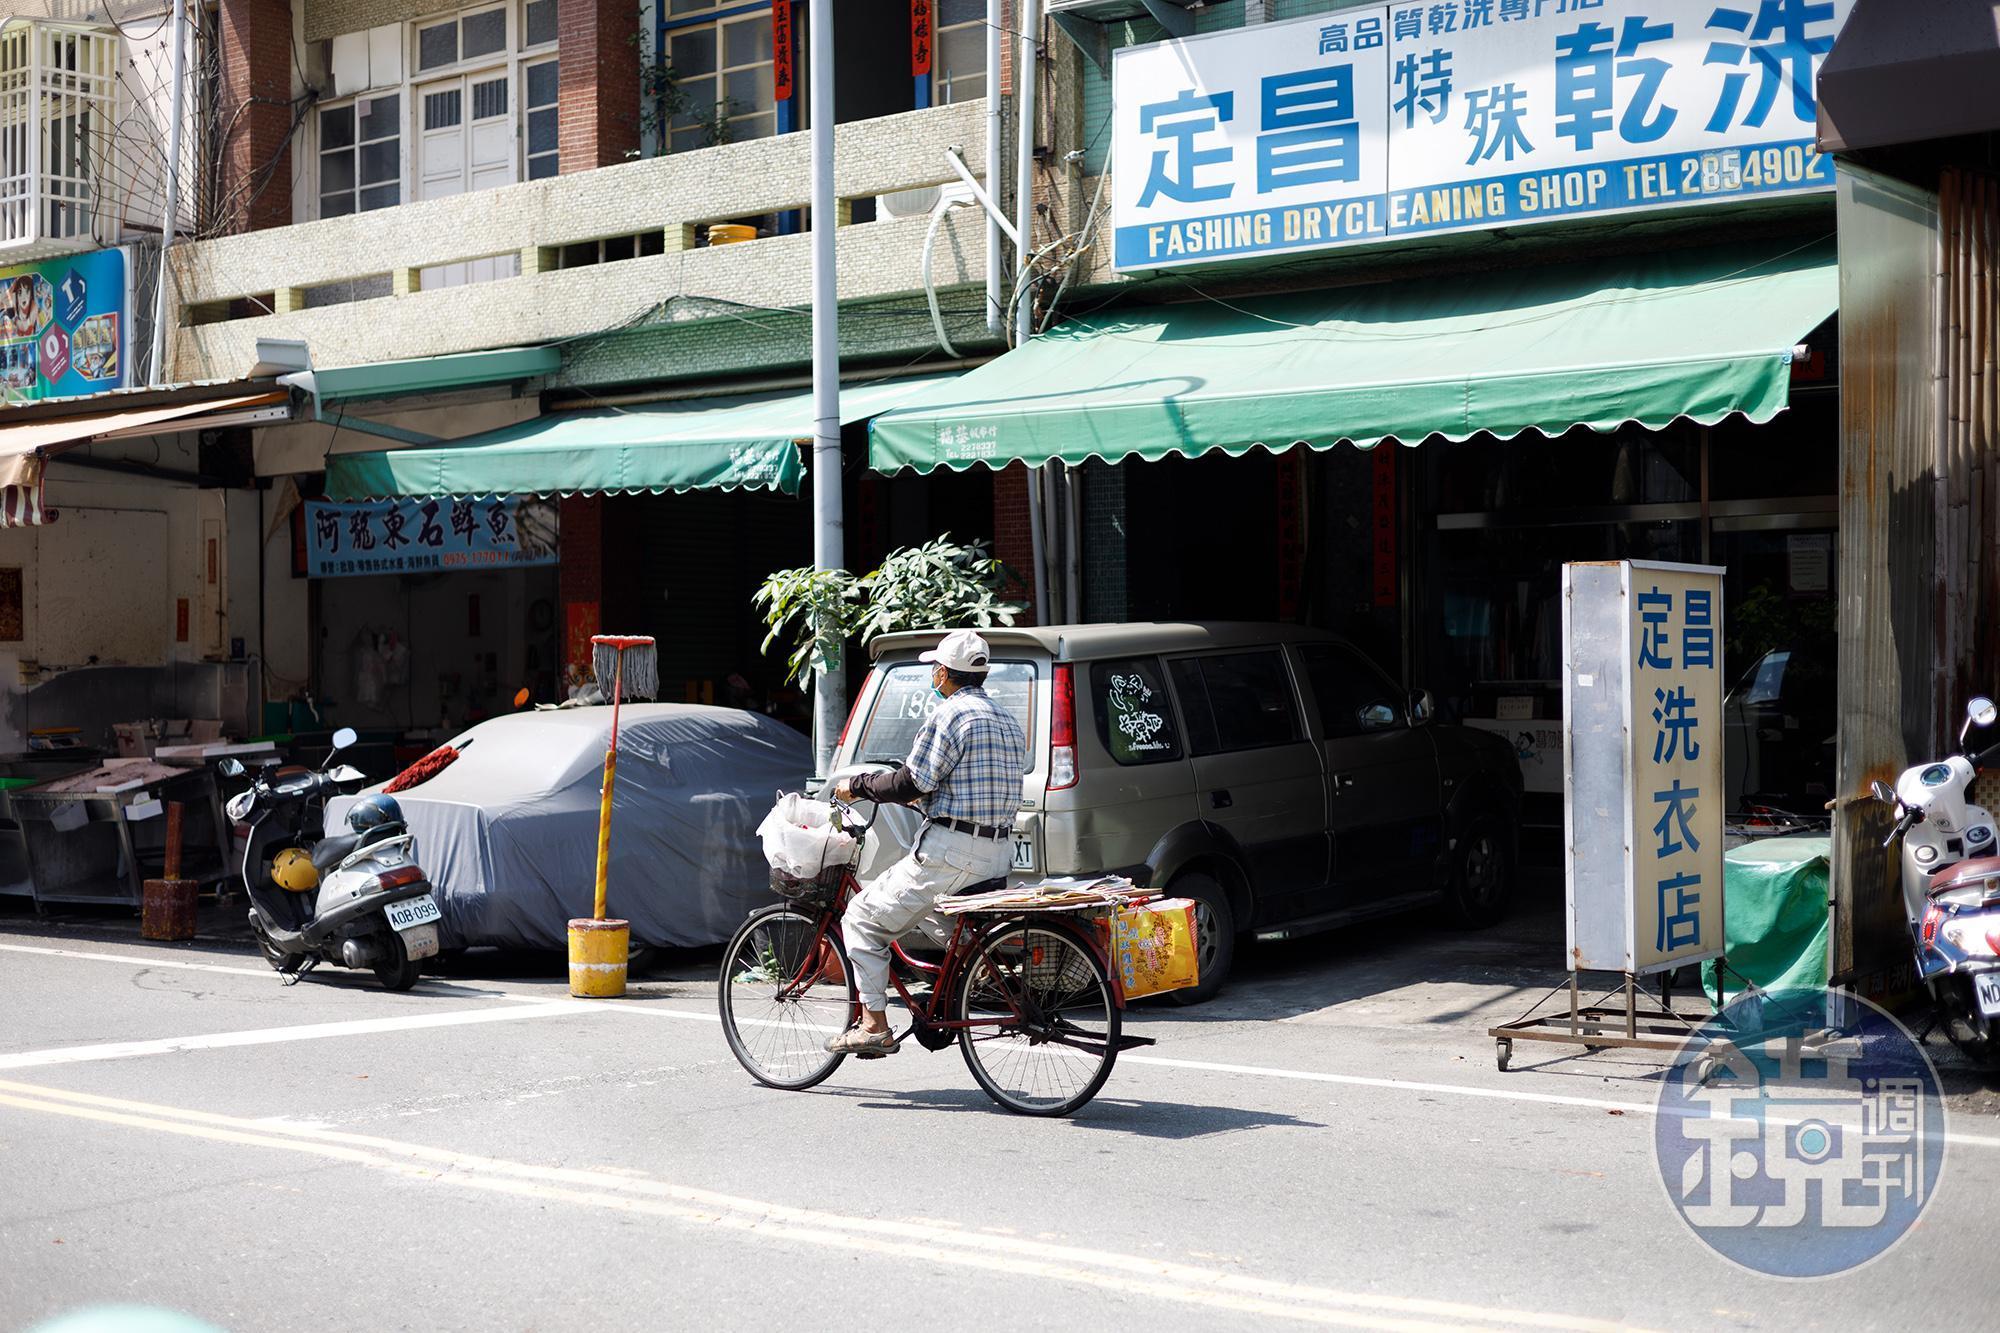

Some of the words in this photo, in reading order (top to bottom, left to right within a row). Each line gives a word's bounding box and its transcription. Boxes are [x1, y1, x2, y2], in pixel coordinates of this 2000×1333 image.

[1136, 63, 1360, 208] 定昌
[1148, 212, 1272, 258] FASHING
[1283, 182, 1504, 242] DRYCLEANING
[1519, 169, 1607, 213] SHOP
[1623, 162, 1676, 200] TEL
[315, 501, 515, 554] 阿龍東石鮮魚
[1637, 586, 1714, 670] 定昌
[1652, 685, 1701, 953] 洗衣店
